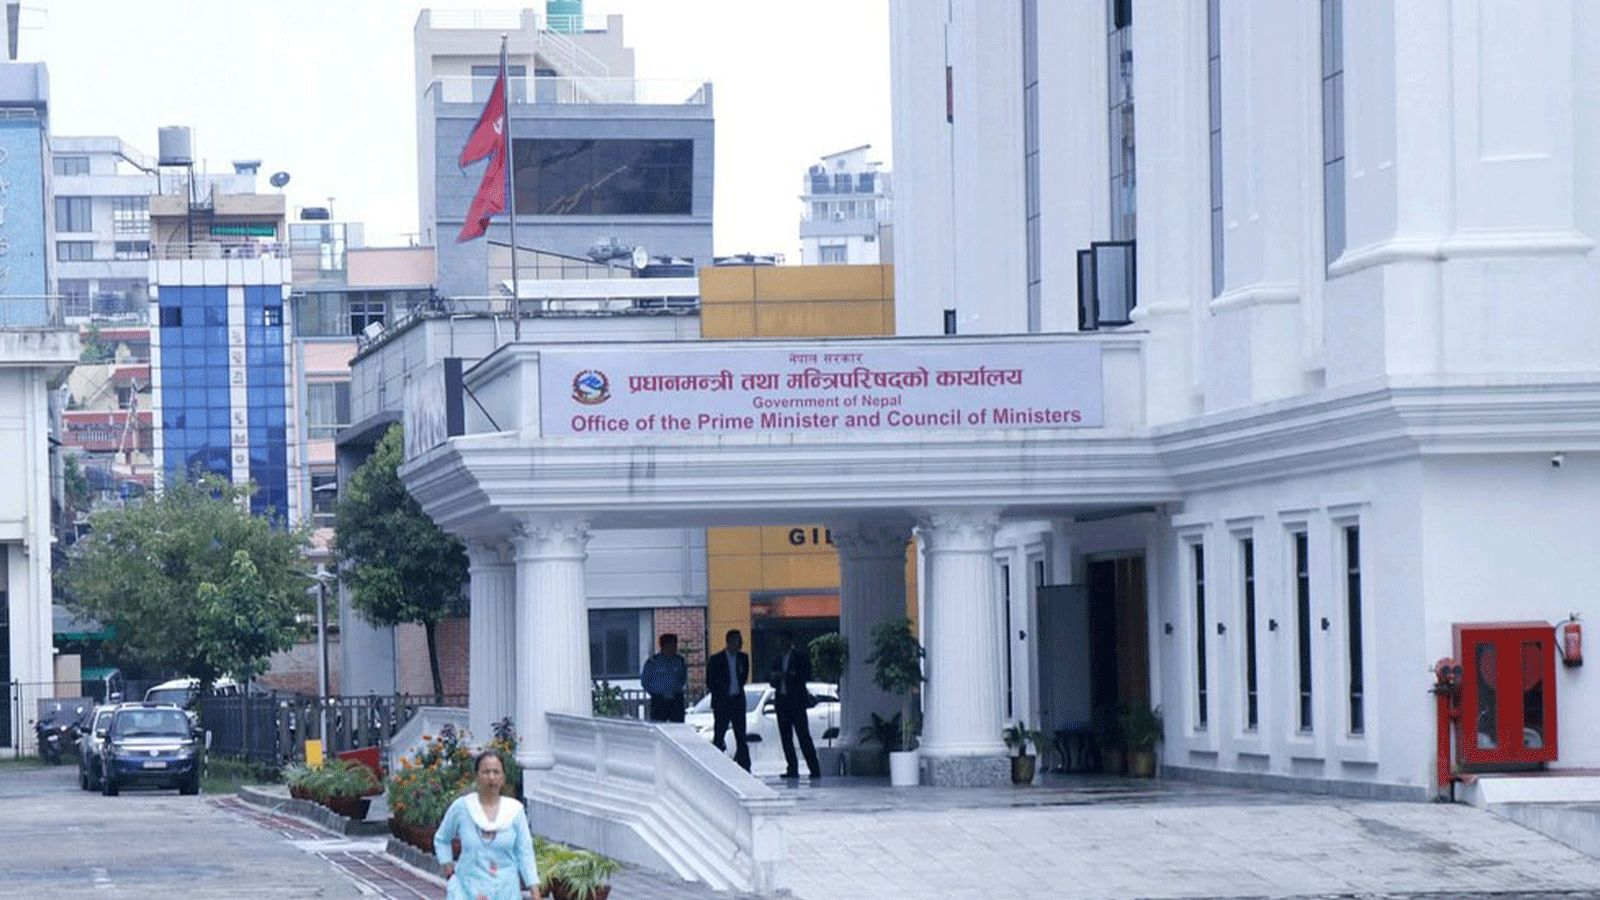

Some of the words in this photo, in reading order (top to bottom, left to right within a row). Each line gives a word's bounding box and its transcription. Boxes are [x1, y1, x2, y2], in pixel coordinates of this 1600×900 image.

[823, 353, 863, 364] सरकार
[629, 370, 733, 393] प्रधानमन्त्री
[742, 374, 779, 390] तथा
[936, 366, 1023, 387] कार्यालय
[753, 396, 838, 408] Government
[844, 396, 857, 407] of
[862, 394, 902, 408] Nepal
[571, 416, 629, 431] Office
[635, 415, 655, 430] of
[660, 415, 691, 430] the
[699, 414, 754, 429] Prime
[761, 412, 839, 428] Minister
[845, 411, 881, 426] and
[887, 409, 960, 426] Council
[967, 408, 987, 424] of
[993, 407, 1082, 424] Ministers
